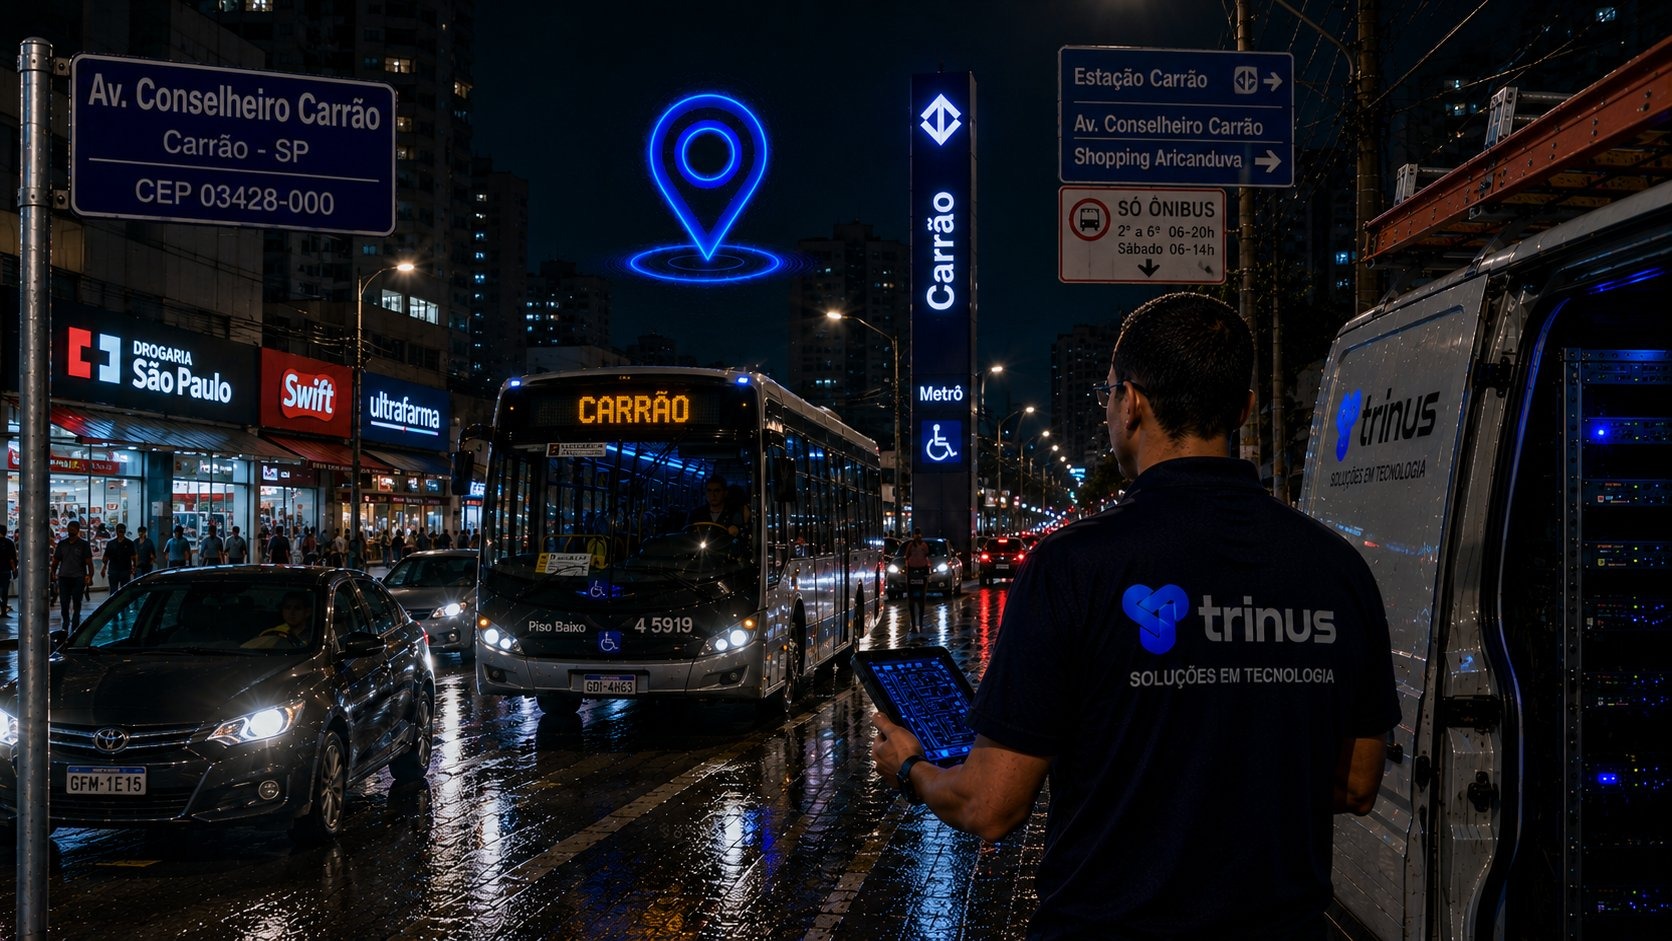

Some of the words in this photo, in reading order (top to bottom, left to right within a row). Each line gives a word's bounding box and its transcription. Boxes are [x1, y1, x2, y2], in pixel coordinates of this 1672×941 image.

[1074, 67, 1144, 91] Estação
[1150, 69, 1208, 88] Carrão
[89, 73, 127, 108] Av.
[137, 77, 291, 122] Conselheiro
[299, 93, 381, 131] Carrão
[1073, 113, 1099, 133] Av.
[1104, 114, 1203, 135] Conselheiro
[1208, 116, 1264, 136] Carrão
[163, 129, 249, 159] Carrão
[275, 138, 309, 163] SP
[1074, 147, 1150, 170] Shopping
[1154, 149, 1243, 169] Aricanduva
[135, 178, 192, 205] CEP
[200, 183, 335, 216] 03428-000
[1118, 195, 1142, 217] SÓ
[1149, 195, 1215, 218] ÔNIBUS
[1135, 228, 1143, 238] a
[1168, 225, 1215, 239] 06-20h
[927, 191, 955, 311] Carrão
[1117, 241, 1164, 255] Sábado
[1169, 242, 1215, 256] 06-14h
[133, 340, 193, 366] DROGARIA
[132, 358, 174, 393] São
[177, 367, 232, 404] Paulo
[282, 373, 335, 415] Swift
[919, 385, 964, 402] Metrô
[369, 391, 440, 430] ultrafarma
[578, 390, 690, 424] CARRÃO
[1359, 387, 1441, 447] trinus
[1329, 466, 1363, 491] SOLUÇÕES
[1364, 467, 1375, 484] EM
[1376, 459, 1426, 482] TECNOLOGIA
[528, 620, 553, 632] Piso
[555, 620, 587, 633] Baixo
[634, 617, 647, 634] 4
[651, 617, 693, 634] 5919
[1198, 595, 1337, 644] trinus
[1129, 665, 1217, 690] SOLUÇÕES
[1220, 667, 1241, 684] EM
[1243, 667, 1335, 684] TECNOLOGIA
